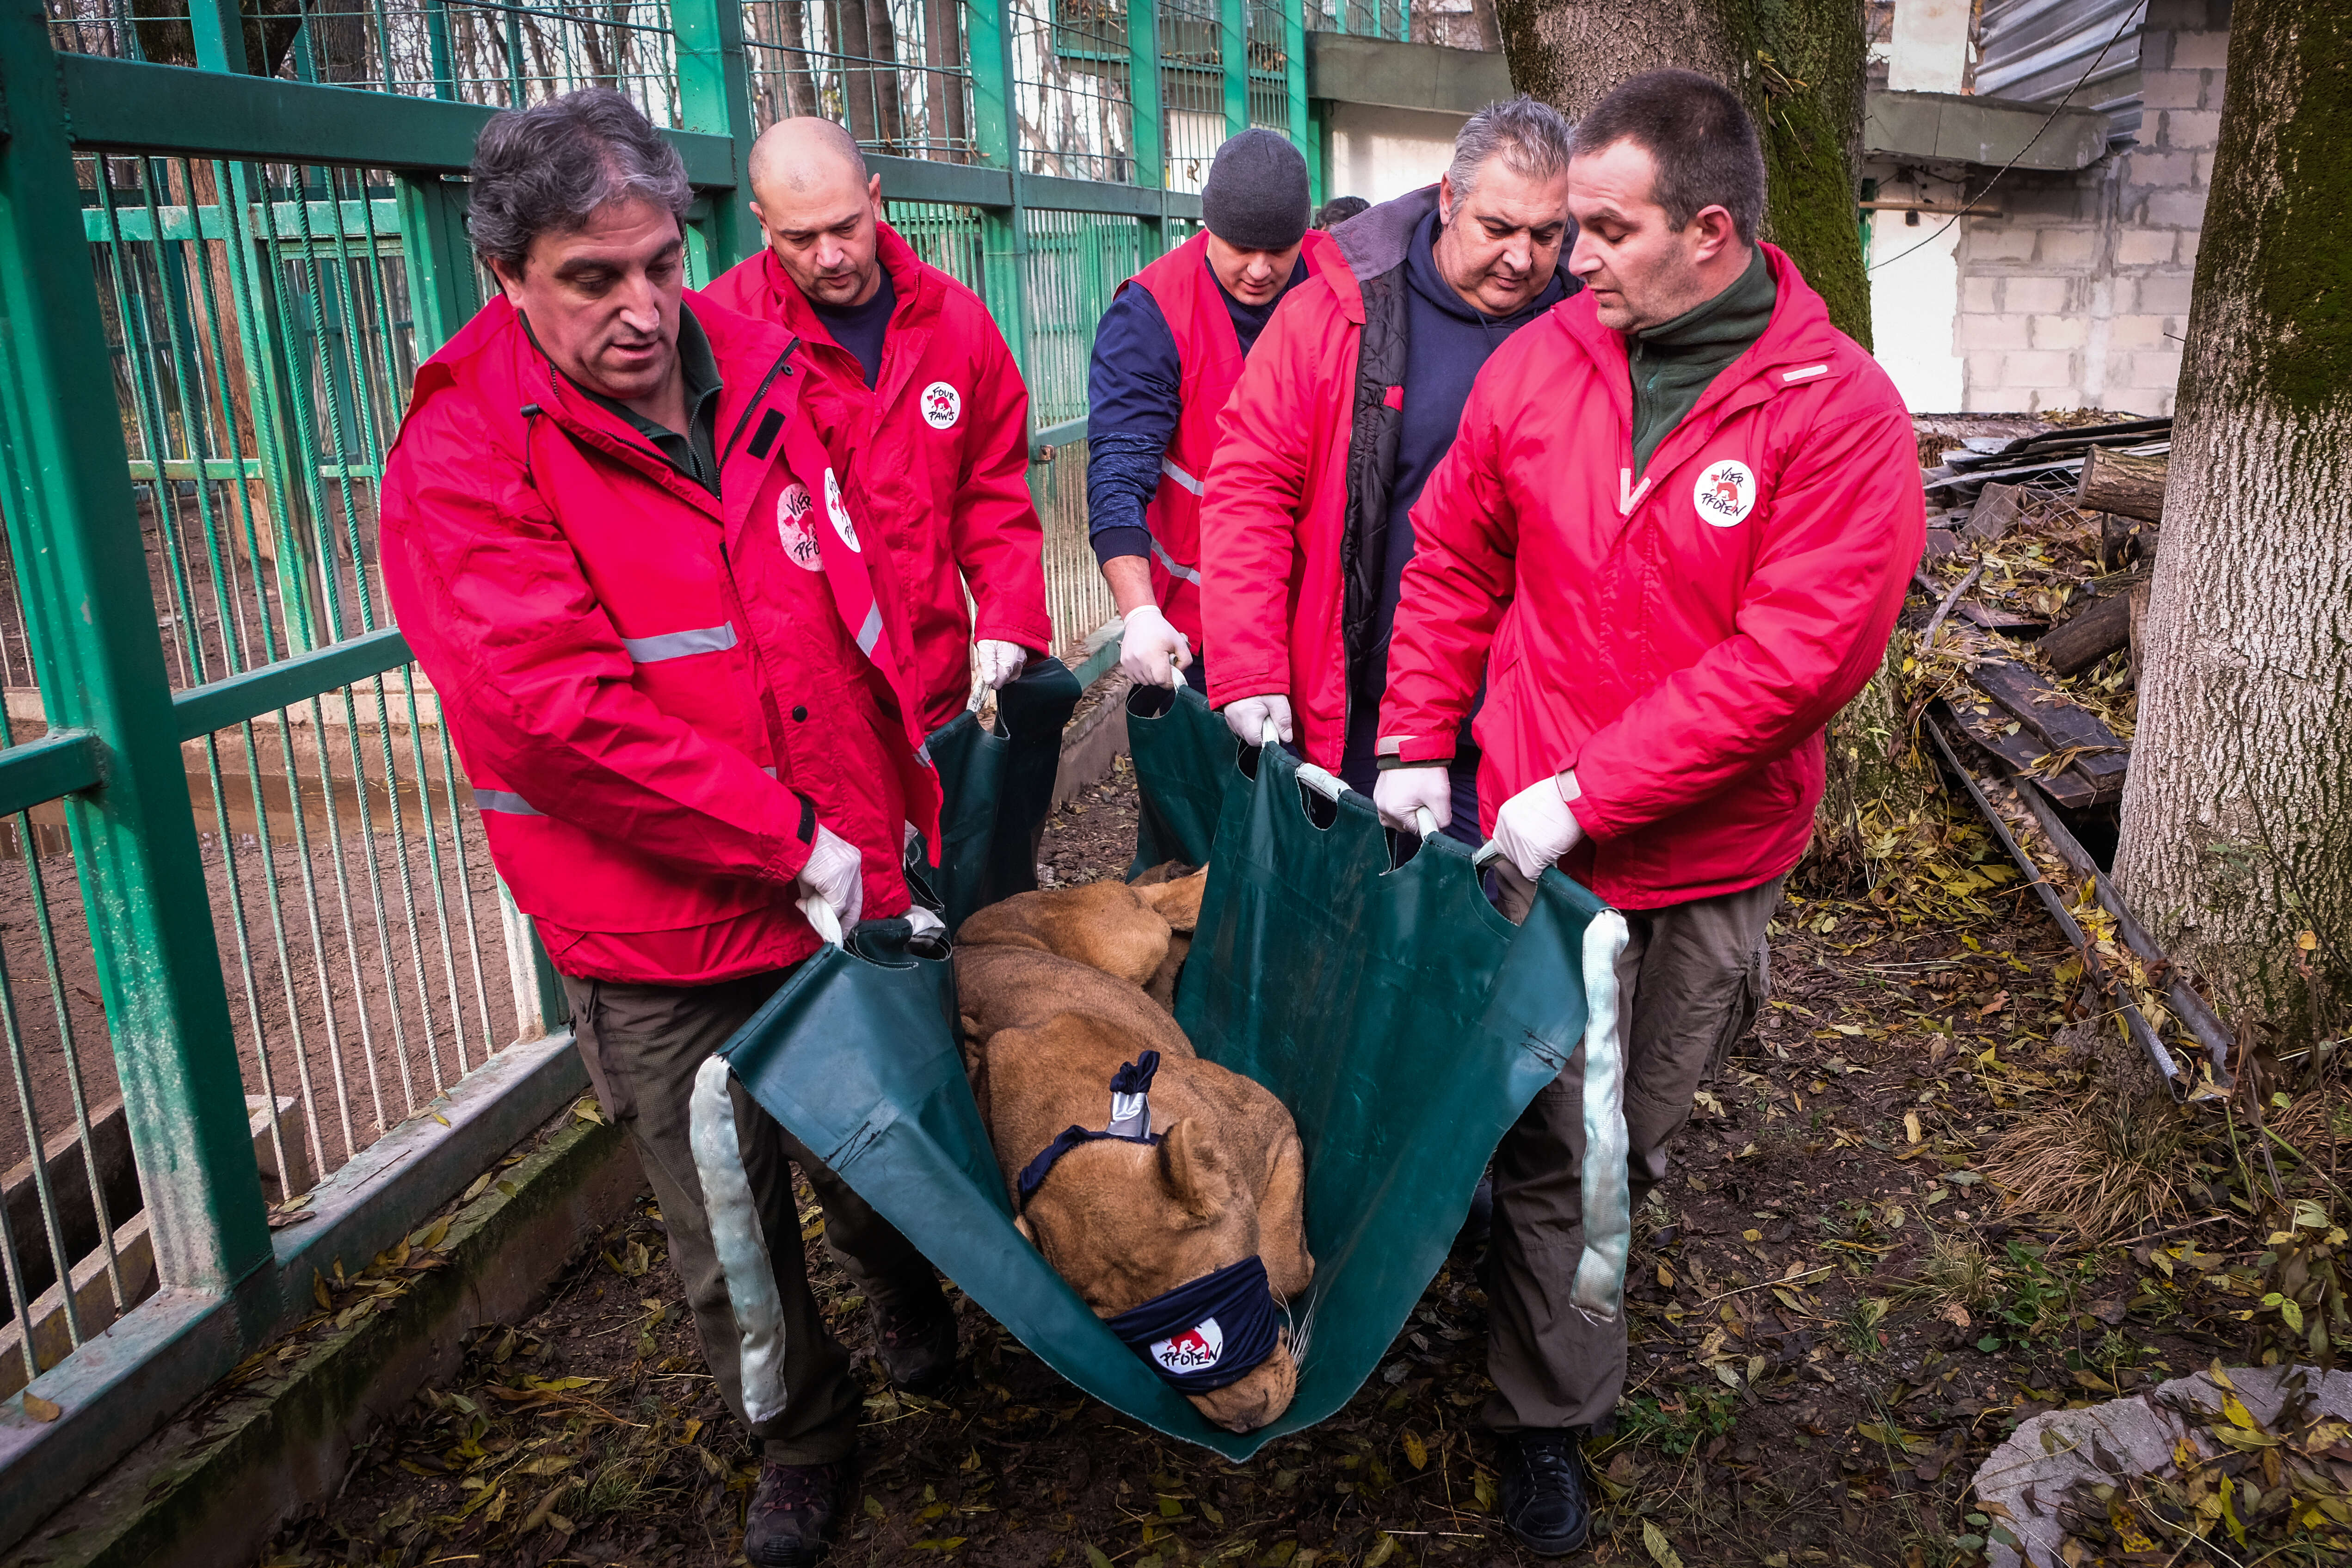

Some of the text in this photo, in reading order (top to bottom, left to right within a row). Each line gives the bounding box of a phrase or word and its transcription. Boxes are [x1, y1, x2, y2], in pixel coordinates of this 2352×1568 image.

[932, 386, 955, 401] FOUR
[929, 411, 955, 421] PAWS
[1701, 493, 1748, 517] PFOTEN
[1159, 1341, 1221, 1366] PFOTEN
